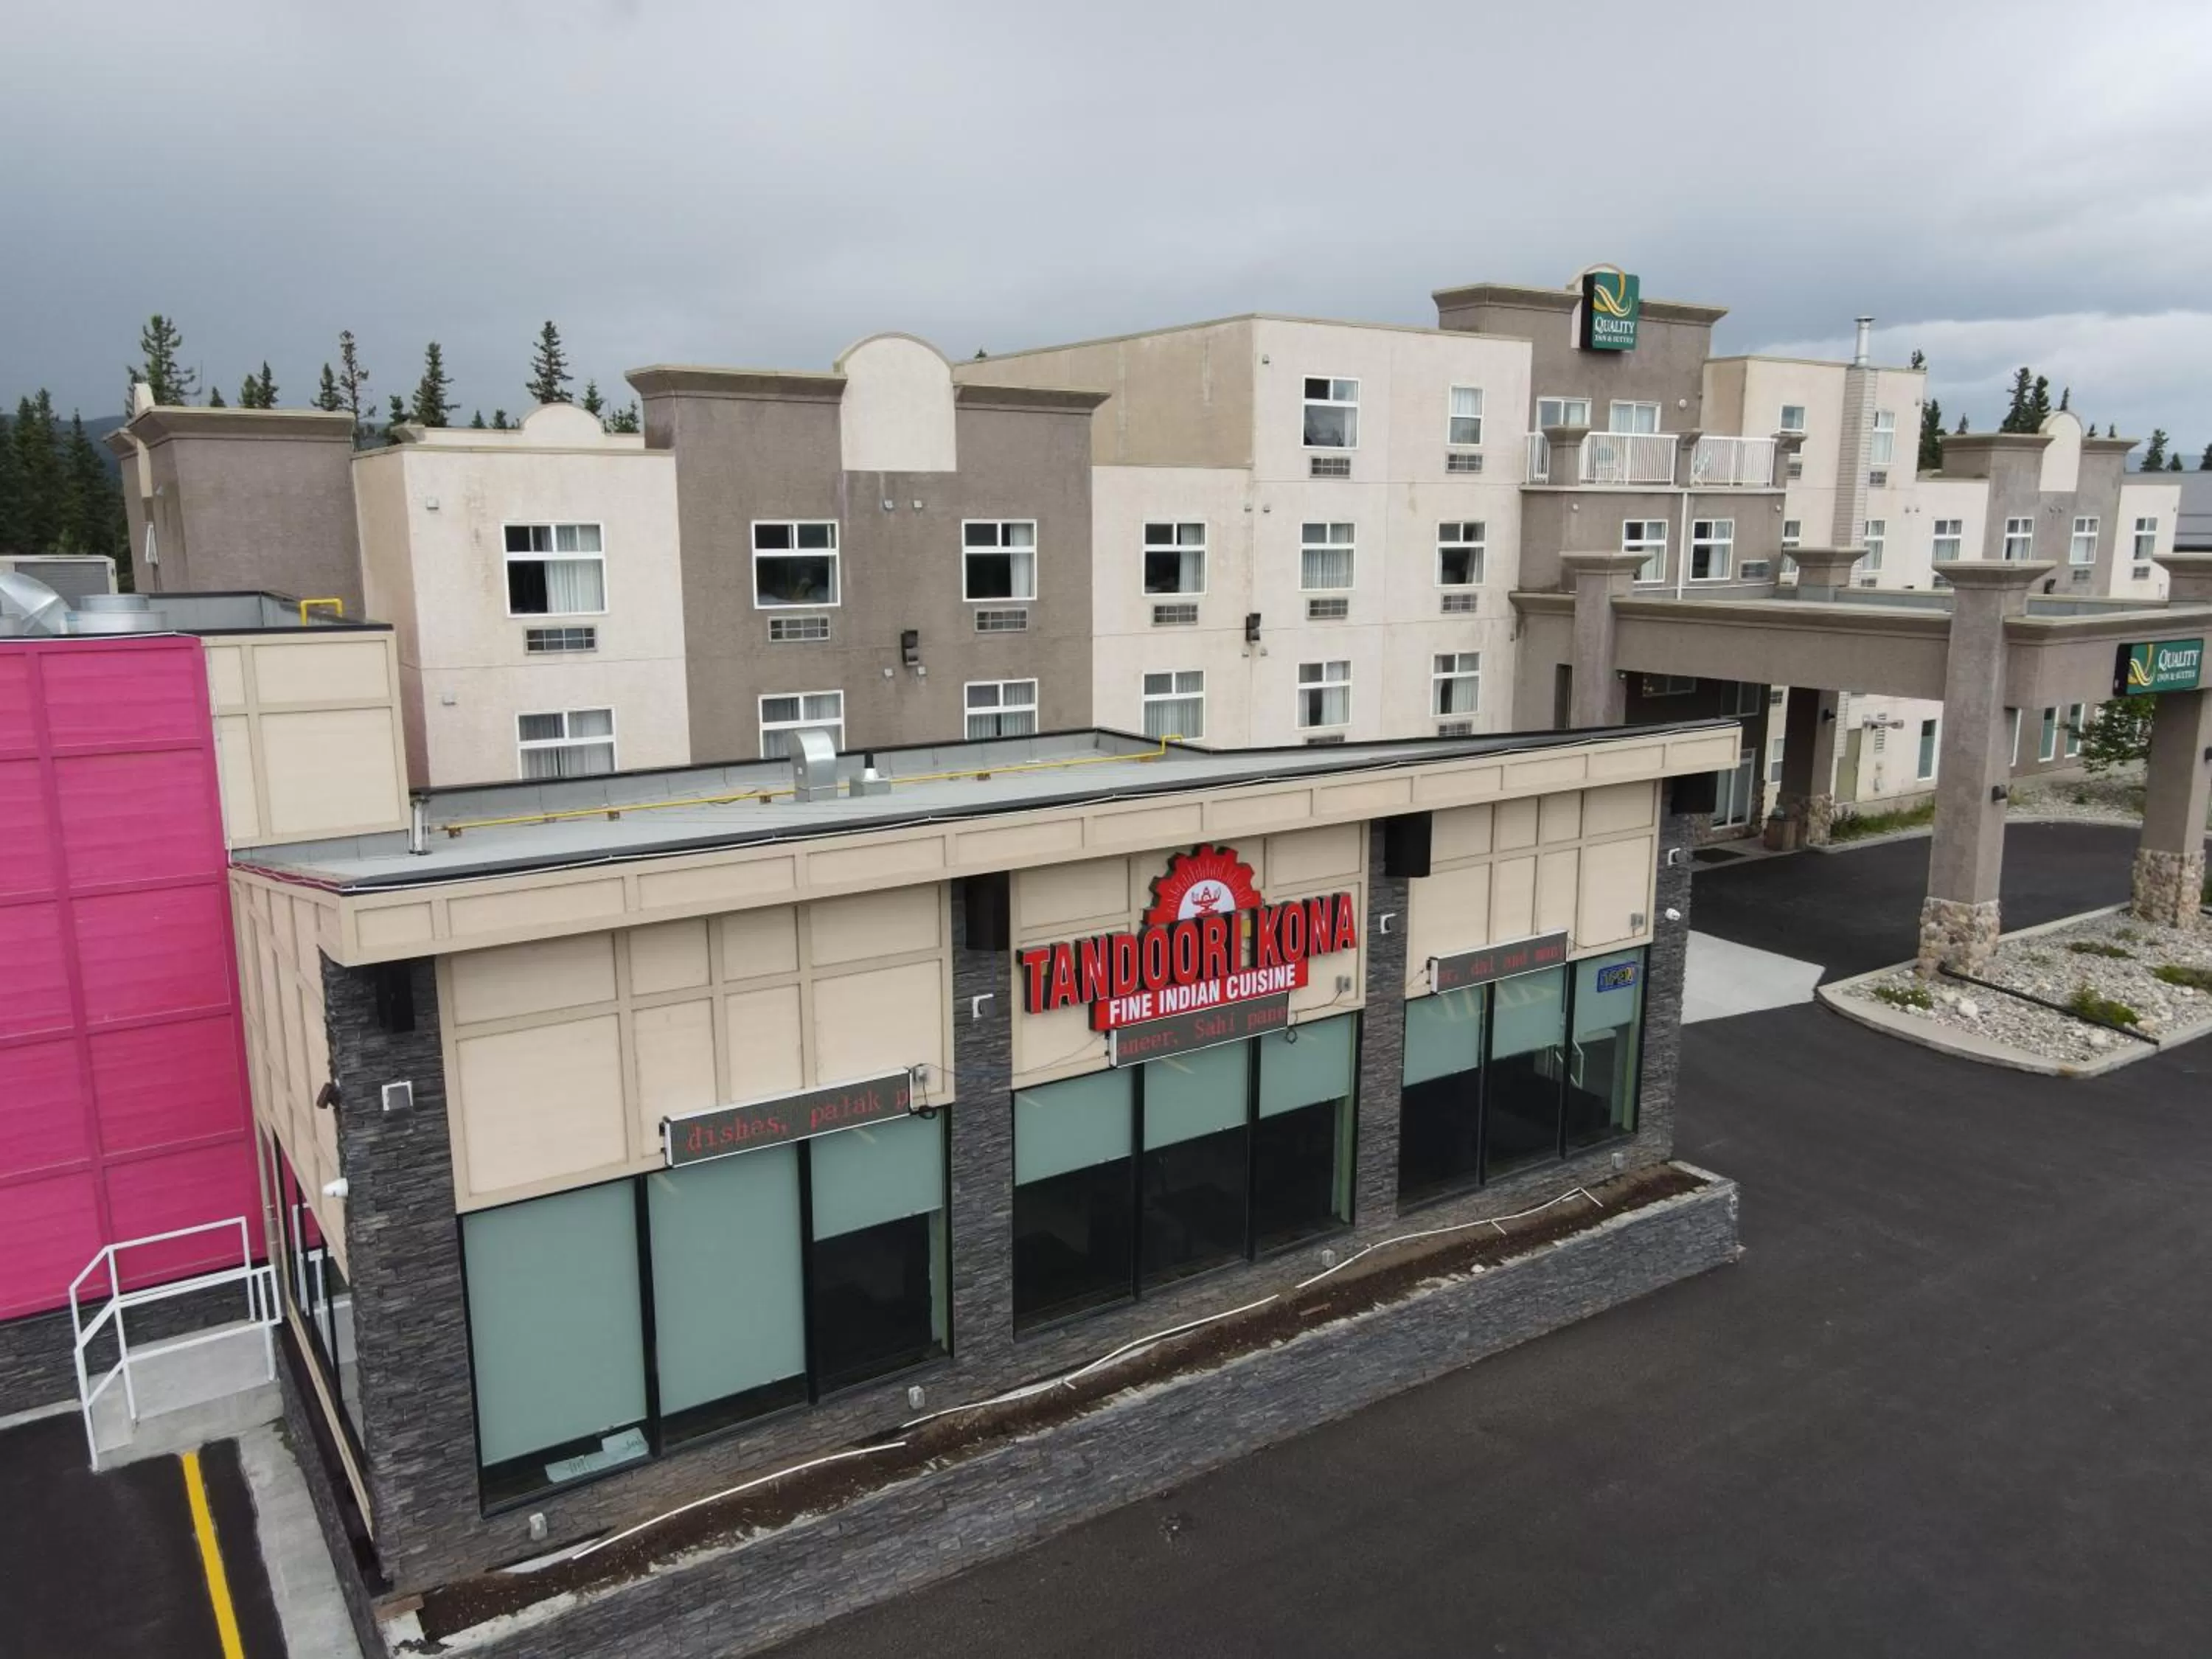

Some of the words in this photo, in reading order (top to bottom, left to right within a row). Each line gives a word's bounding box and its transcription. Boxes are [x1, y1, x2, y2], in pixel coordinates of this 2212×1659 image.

[1594, 316, 1635, 334] QUALITY
[2158, 649, 2200, 671] QUALITY
[1020, 911, 1242, 1014] TANDOORI
[1257, 892, 1357, 967] KONA
[1109, 994, 1152, 1024] FINE
[1159, 983, 1220, 1014] INDIAN
[1226, 964, 1295, 997] CUISINE
[810, 1091, 880, 1130] palak
